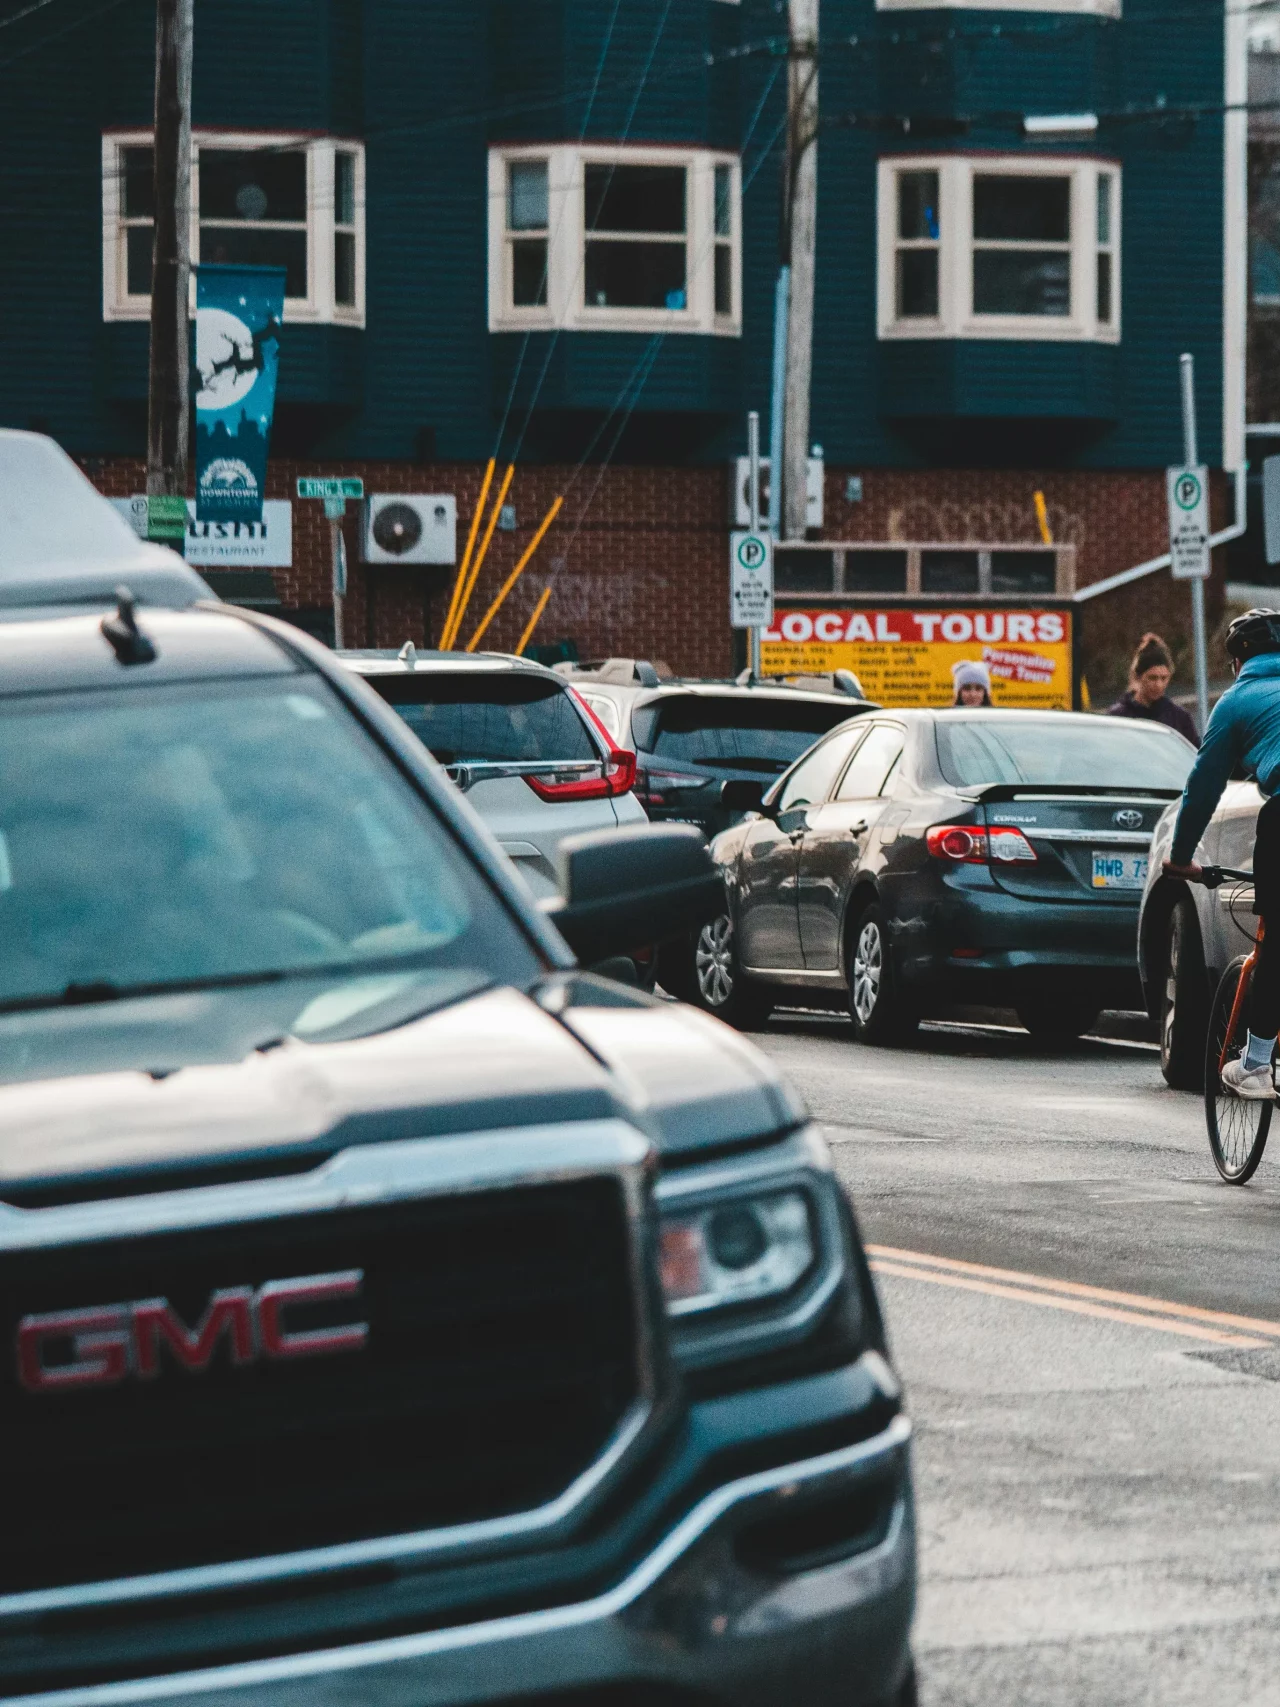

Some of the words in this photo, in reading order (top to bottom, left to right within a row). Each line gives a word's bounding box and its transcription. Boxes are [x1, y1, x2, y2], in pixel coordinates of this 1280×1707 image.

[200, 488, 258, 497] DOWNTOWN
[1182, 481, 1195, 501] P
[746, 544, 759, 561] P
[760, 614, 901, 642] LOCAL
[913, 614, 1064, 642] TOURS
[1017, 665, 1052, 684] Tours
[994, 815, 1037, 823] COROLLA
[1095, 859, 1124, 877] HWB
[18, 1267, 370, 1391] GMC
